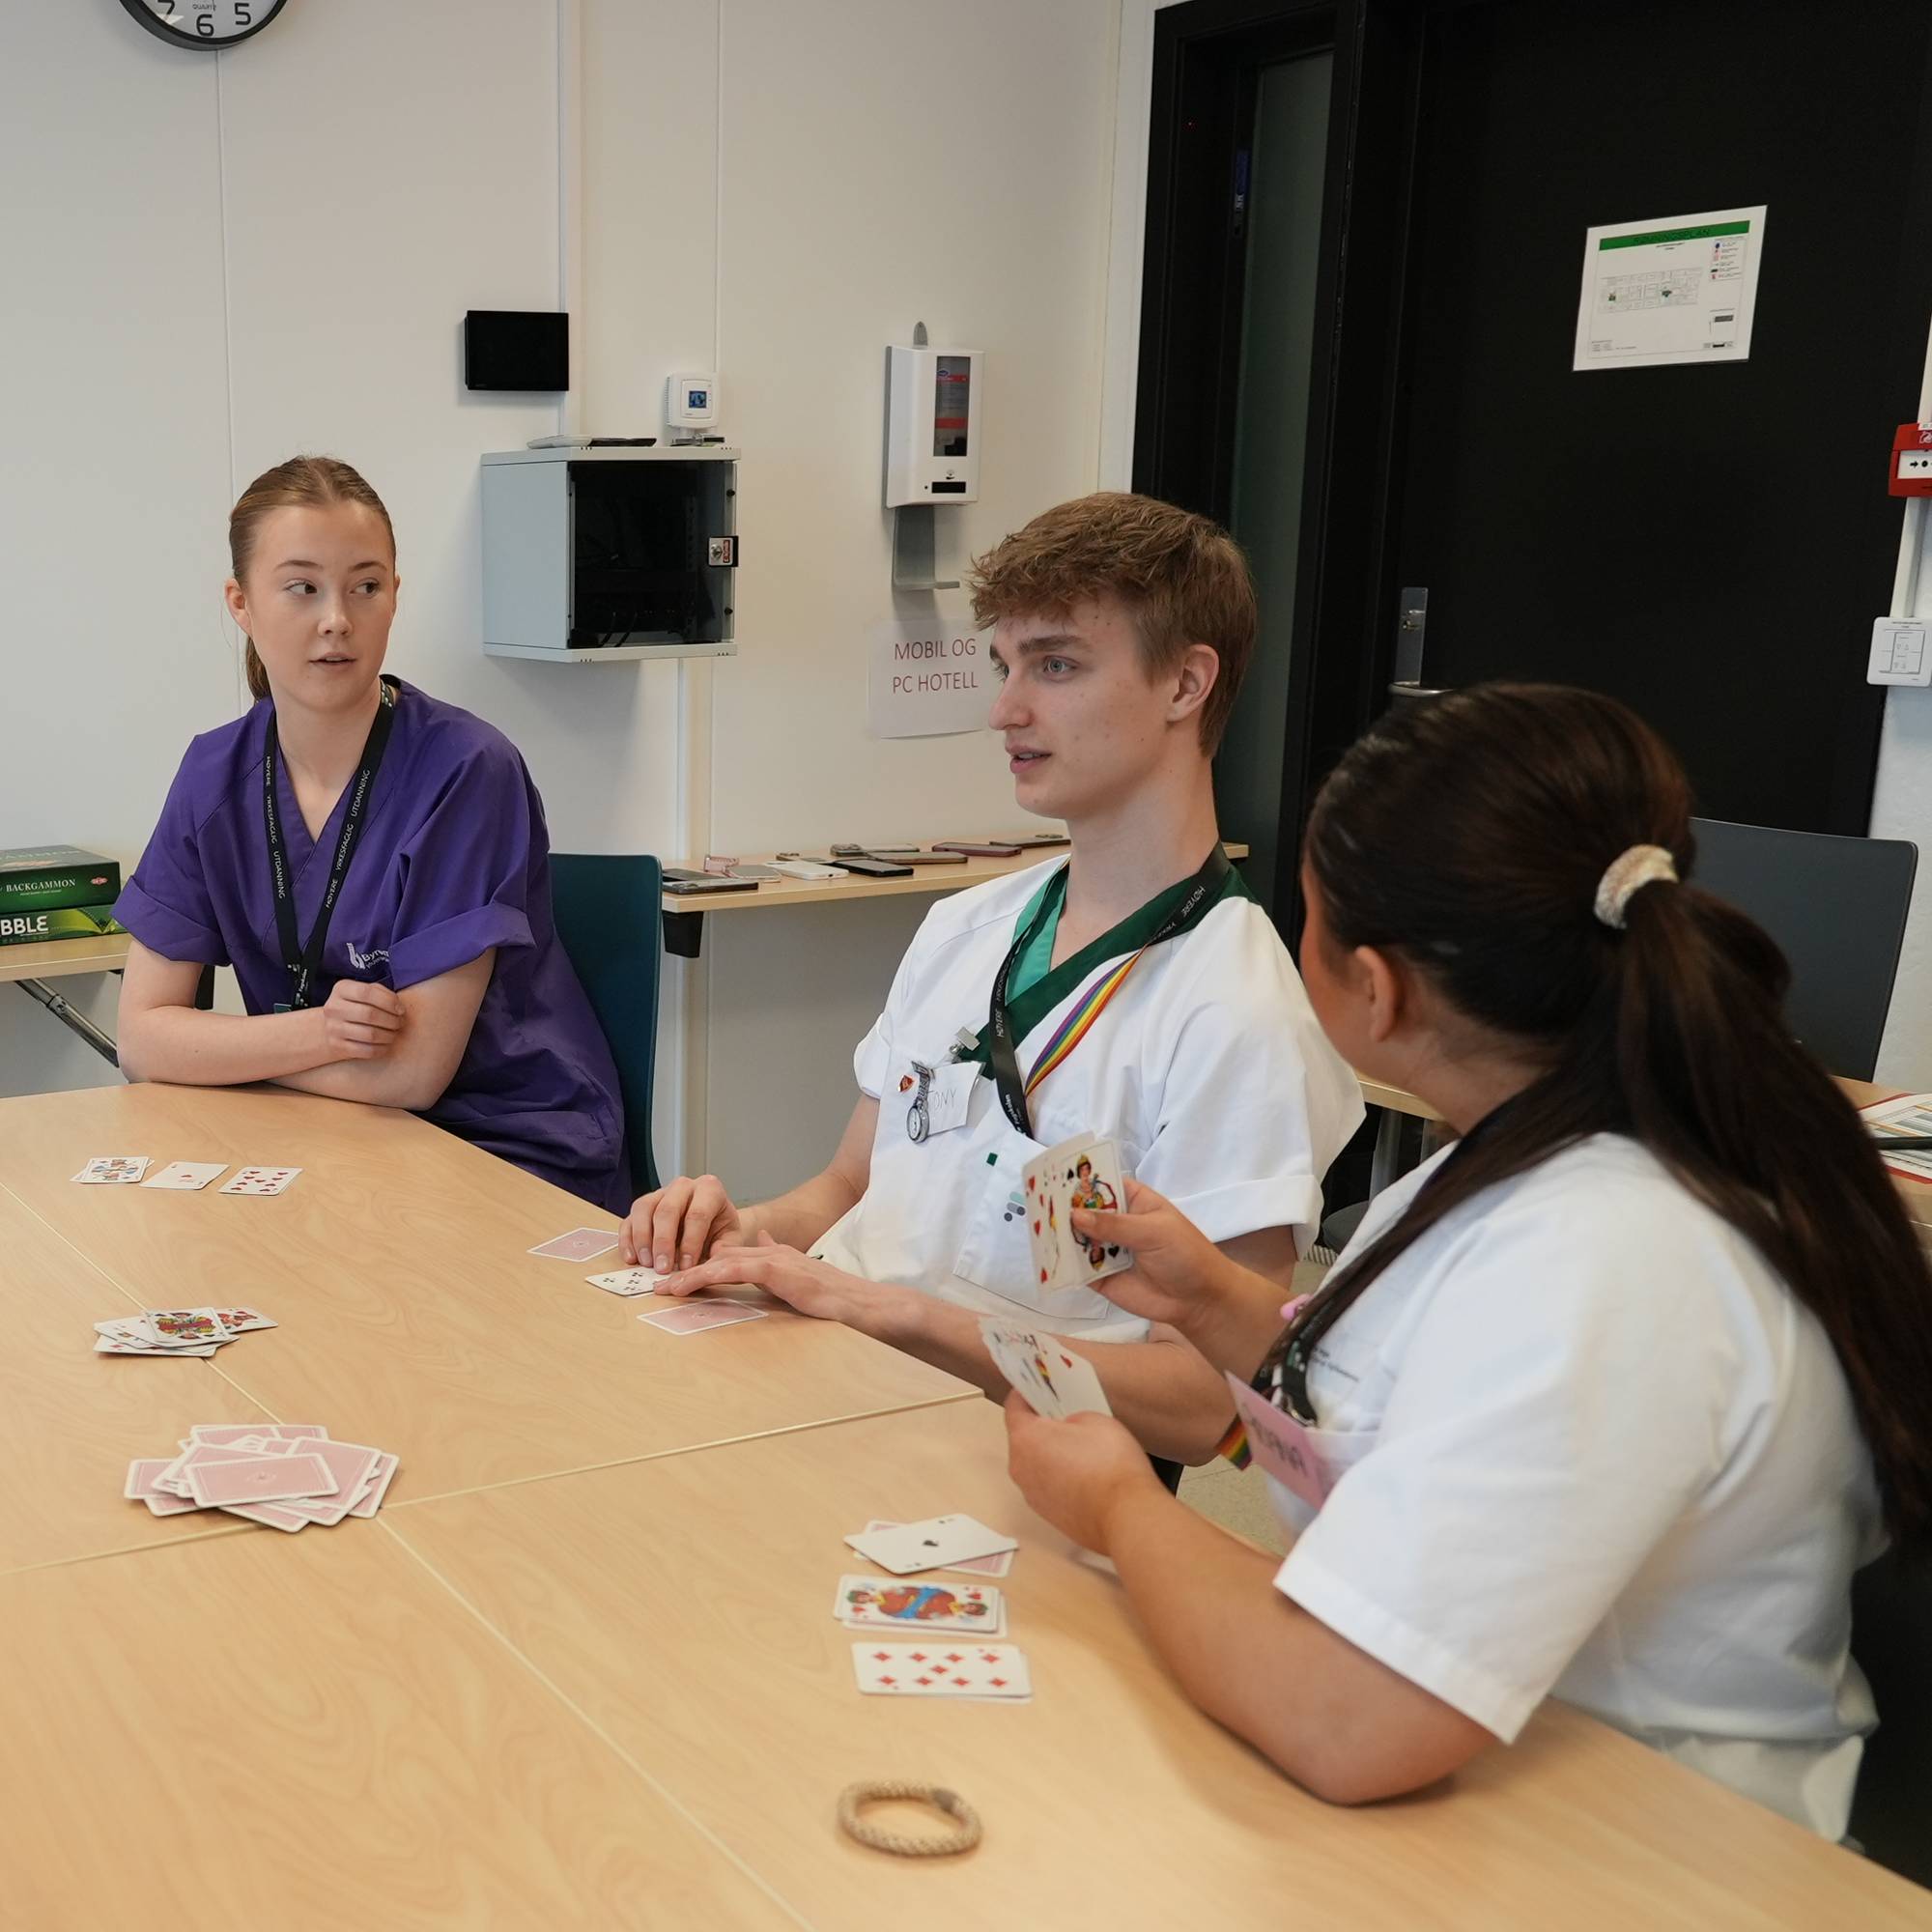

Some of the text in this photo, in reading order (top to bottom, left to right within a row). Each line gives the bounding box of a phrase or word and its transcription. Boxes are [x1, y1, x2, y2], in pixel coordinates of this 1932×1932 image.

[196, 14, 214, 37] 6
[235, 3, 251, 25] 5
[895, 638, 976, 660] MOBIL OG
[893, 671, 979, 694] PC HOTELL
[335, 822, 355, 870] YRKESFAGLIG
[350, 769, 371, 817] UTDANNING
[6, 878, 76, 892] BACKGAMMON
[273, 850, 286, 899] UTDANNING
